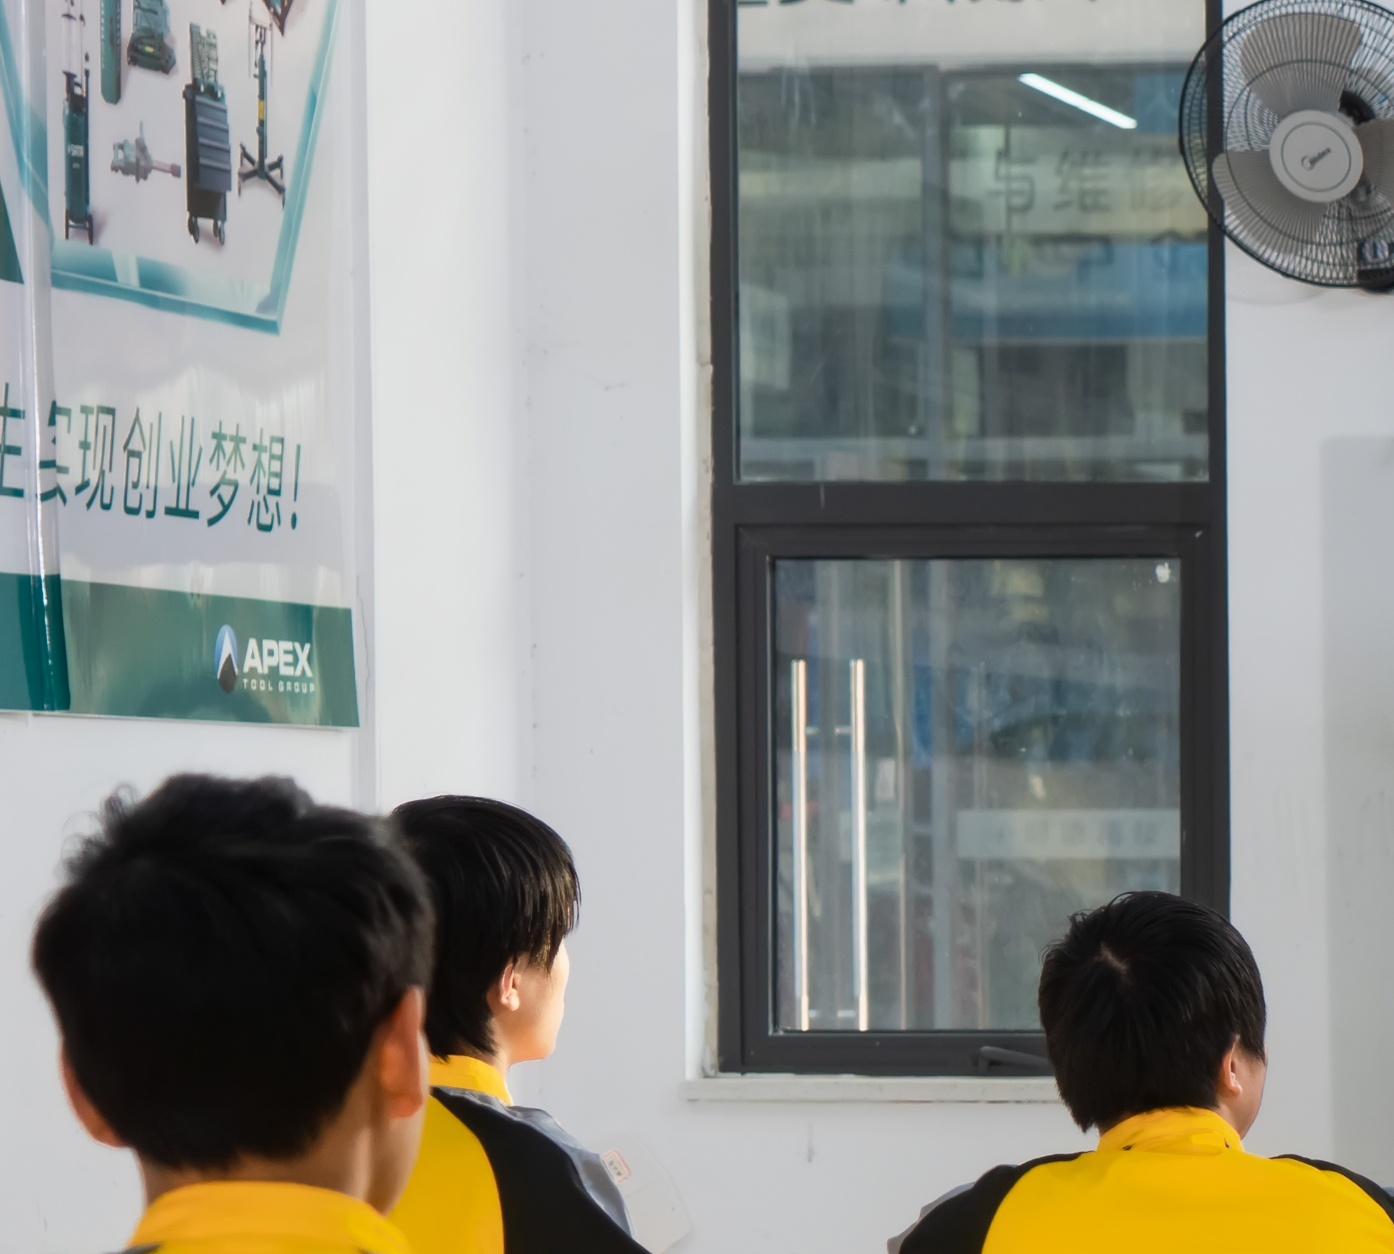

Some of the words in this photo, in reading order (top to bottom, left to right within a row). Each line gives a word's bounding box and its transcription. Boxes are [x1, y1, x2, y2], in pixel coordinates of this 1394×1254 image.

[243, 637, 313, 678] APEX
[242, 678, 273, 692] TOOL
[279, 680, 315, 694] GROUP
